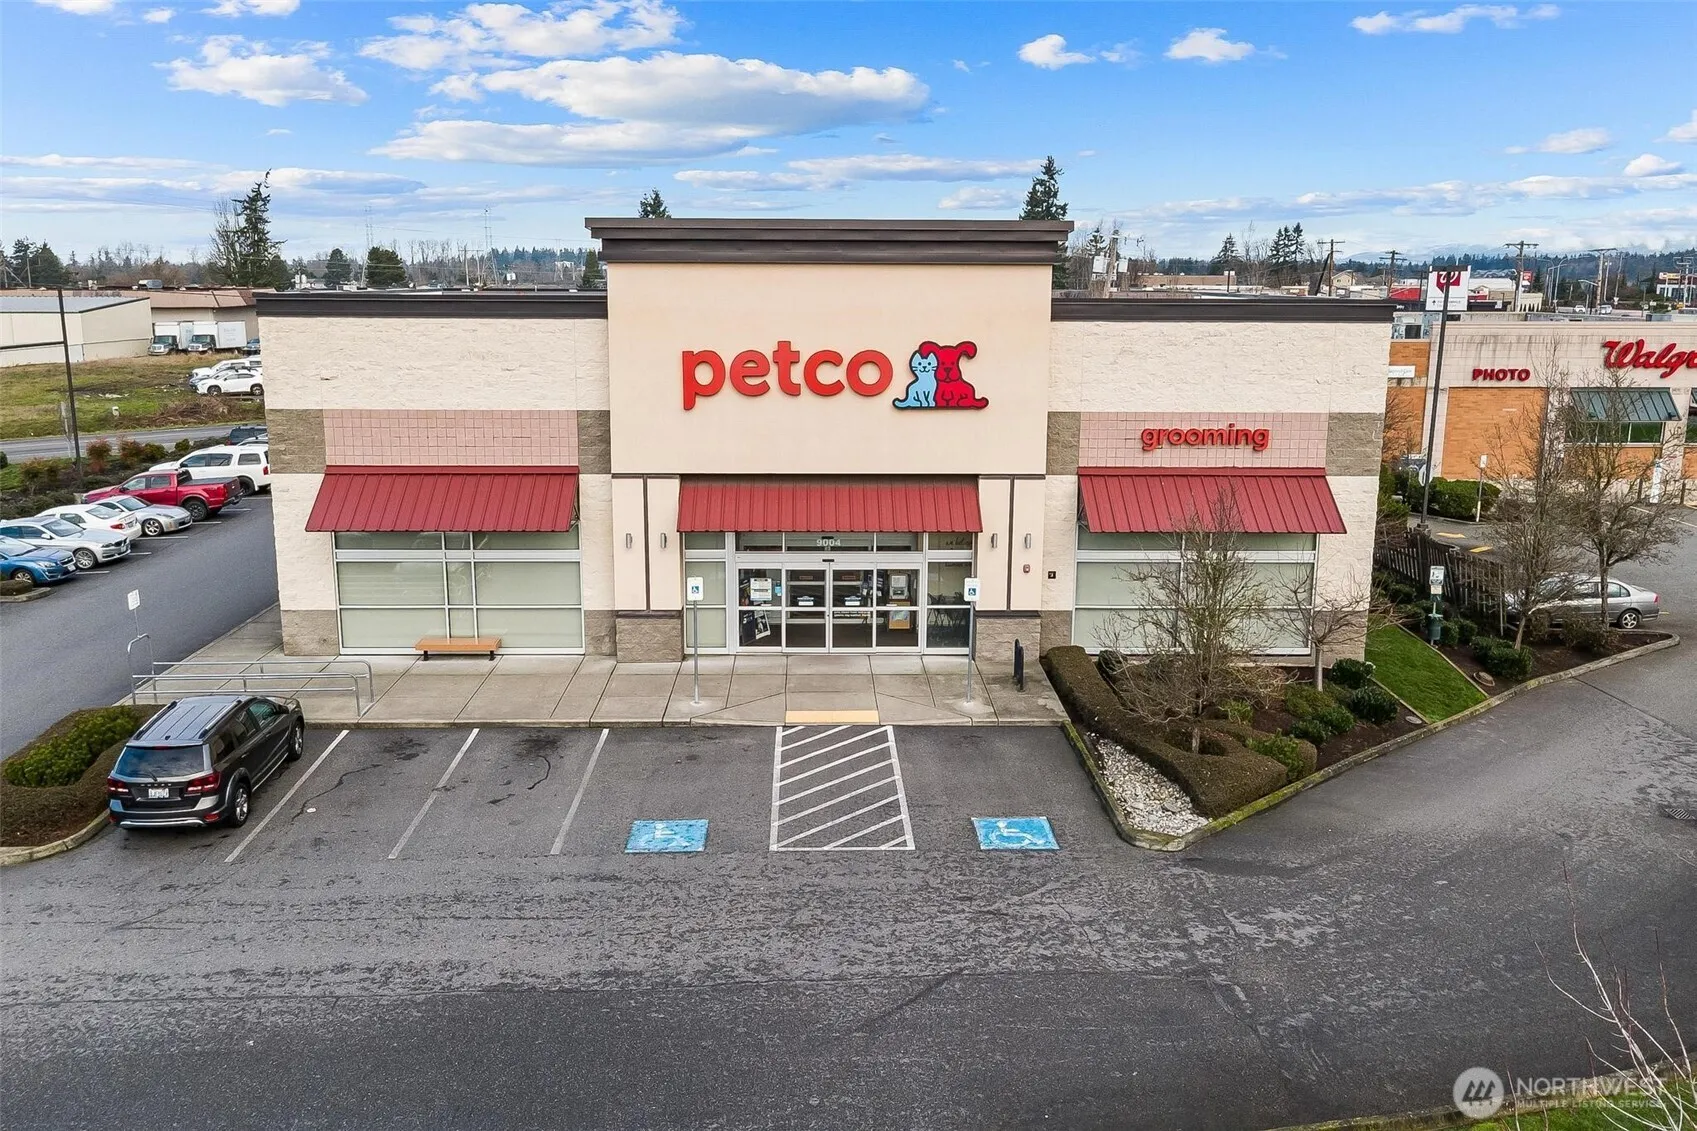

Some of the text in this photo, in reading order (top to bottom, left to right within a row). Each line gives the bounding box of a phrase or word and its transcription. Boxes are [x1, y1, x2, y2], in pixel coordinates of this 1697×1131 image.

[682, 340, 893, 410] petco
[1472, 368, 1531, 382] PHOTO
[1141, 423, 1270, 451] grooming
